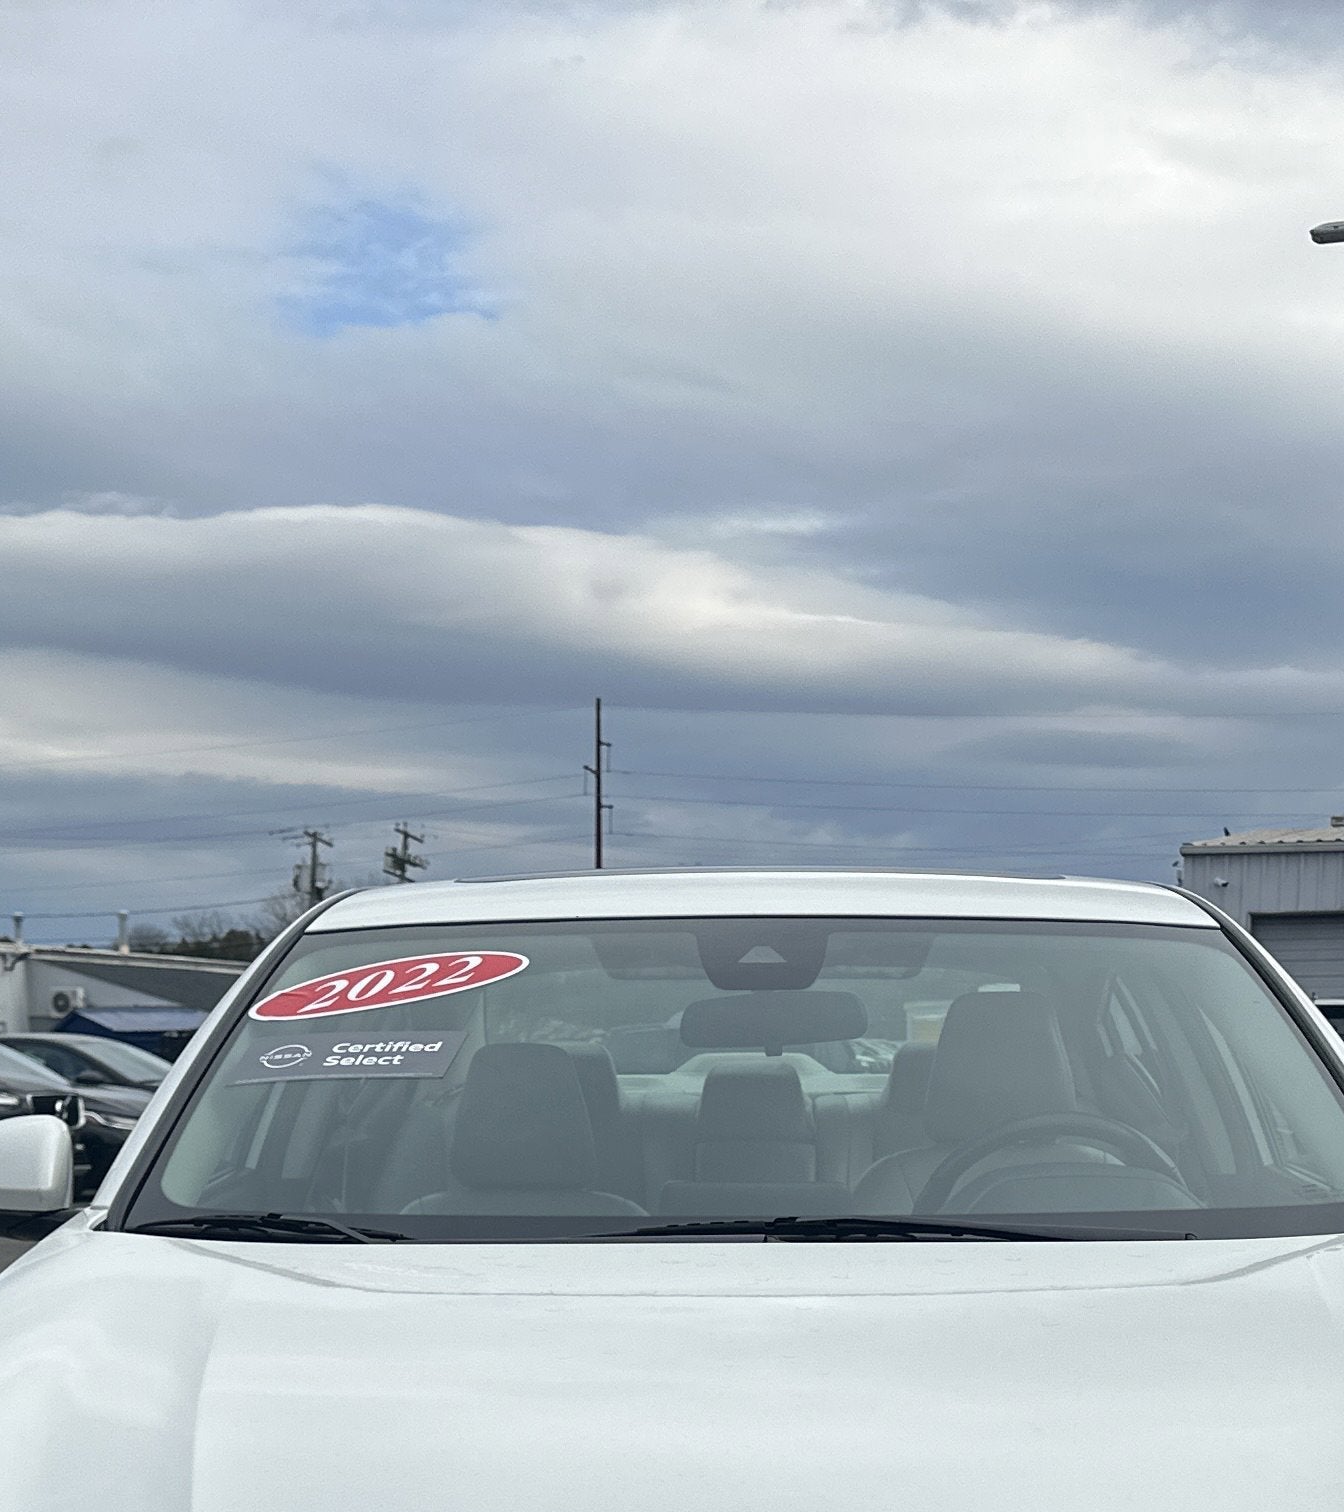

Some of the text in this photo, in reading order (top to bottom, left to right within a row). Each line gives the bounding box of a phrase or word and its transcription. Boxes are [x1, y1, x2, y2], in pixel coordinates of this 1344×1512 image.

[296, 955, 484, 1014] 2022
[332, 1041, 443, 1054] Certified
[259, 1050, 313, 1063] NISSAN
[322, 1054, 405, 1067] Select
